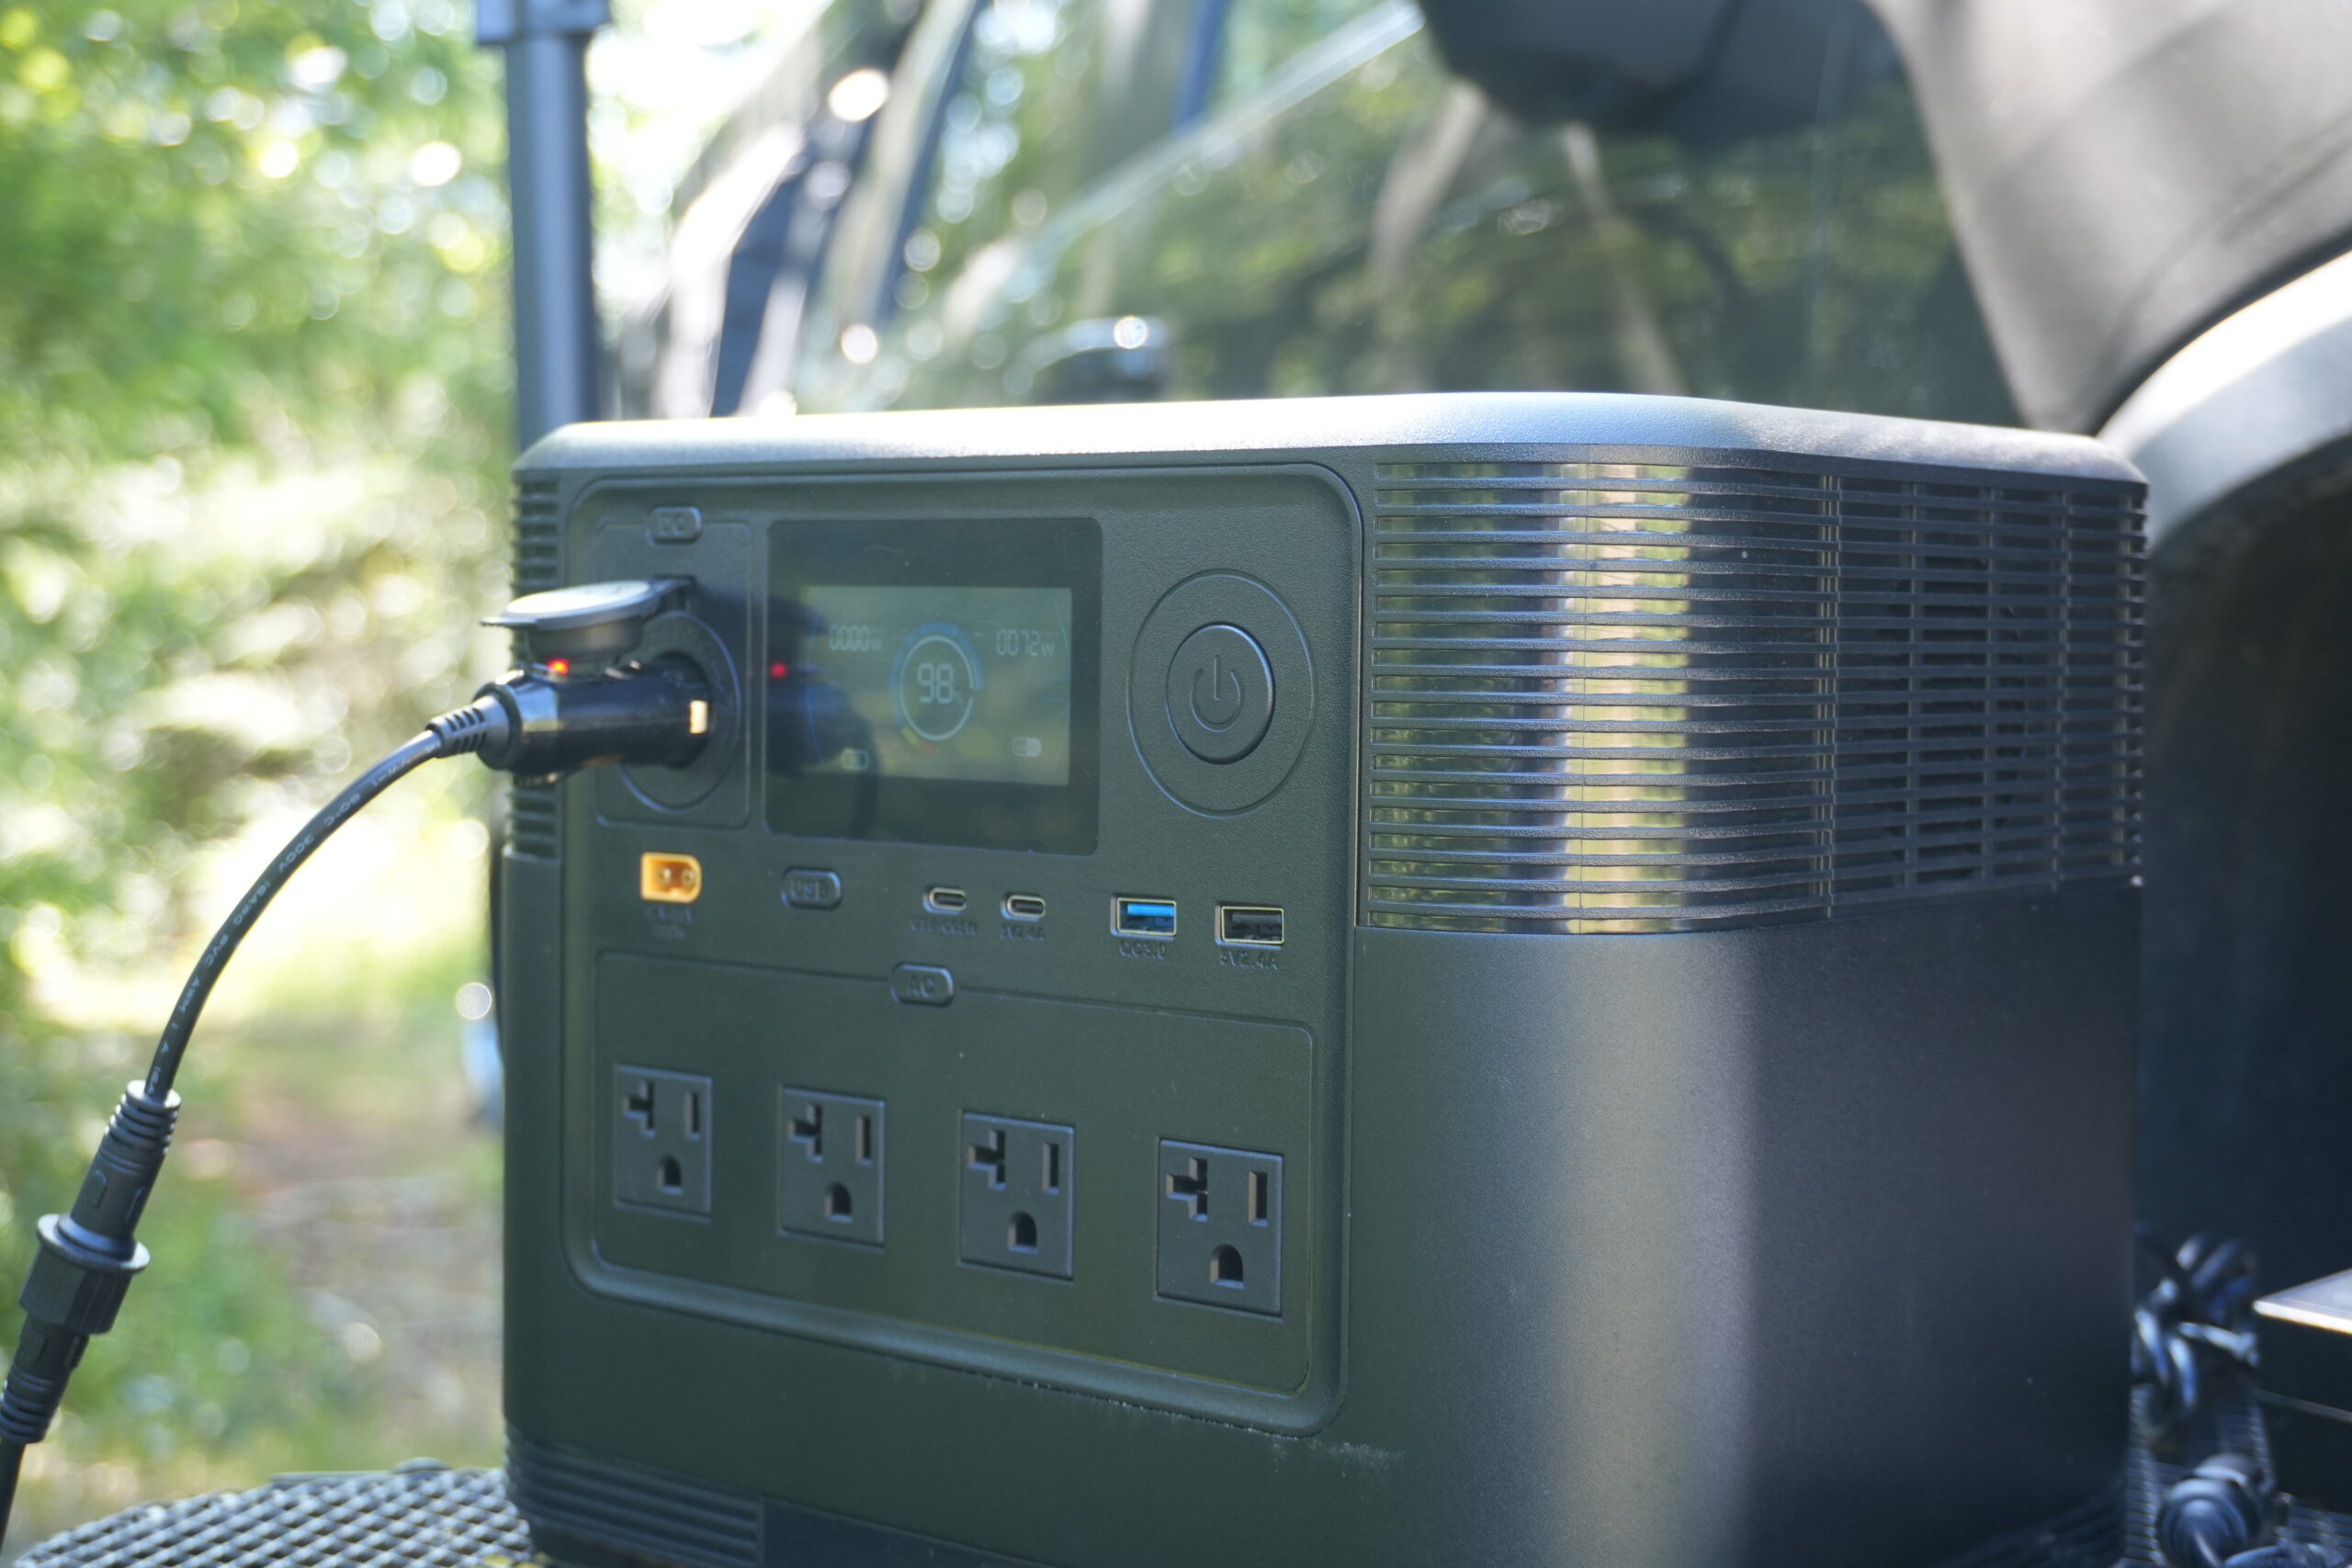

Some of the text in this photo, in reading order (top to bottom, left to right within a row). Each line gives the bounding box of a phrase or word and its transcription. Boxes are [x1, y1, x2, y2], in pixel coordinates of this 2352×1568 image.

[274, 831, 316, 874] 300V
[790, 879, 829, 901] USB
[201, 931, 232, 967] PVC
[904, 973, 938, 998] AC
